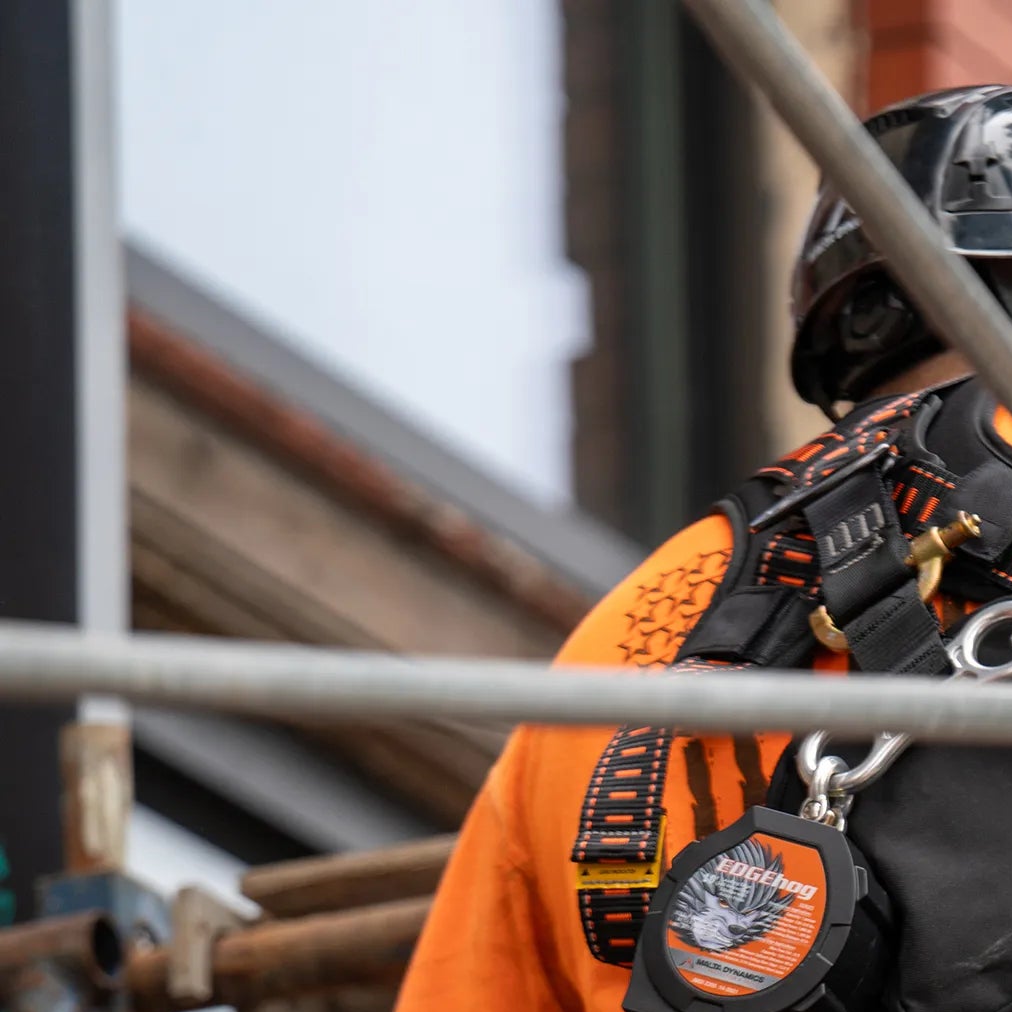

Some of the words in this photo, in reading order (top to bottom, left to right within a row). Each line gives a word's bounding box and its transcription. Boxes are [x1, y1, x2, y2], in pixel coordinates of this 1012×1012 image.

[716, 858, 818, 900] EDGEhog
[695, 957, 723, 973] MALTA
[722, 965, 765, 984] DYNAMICS
